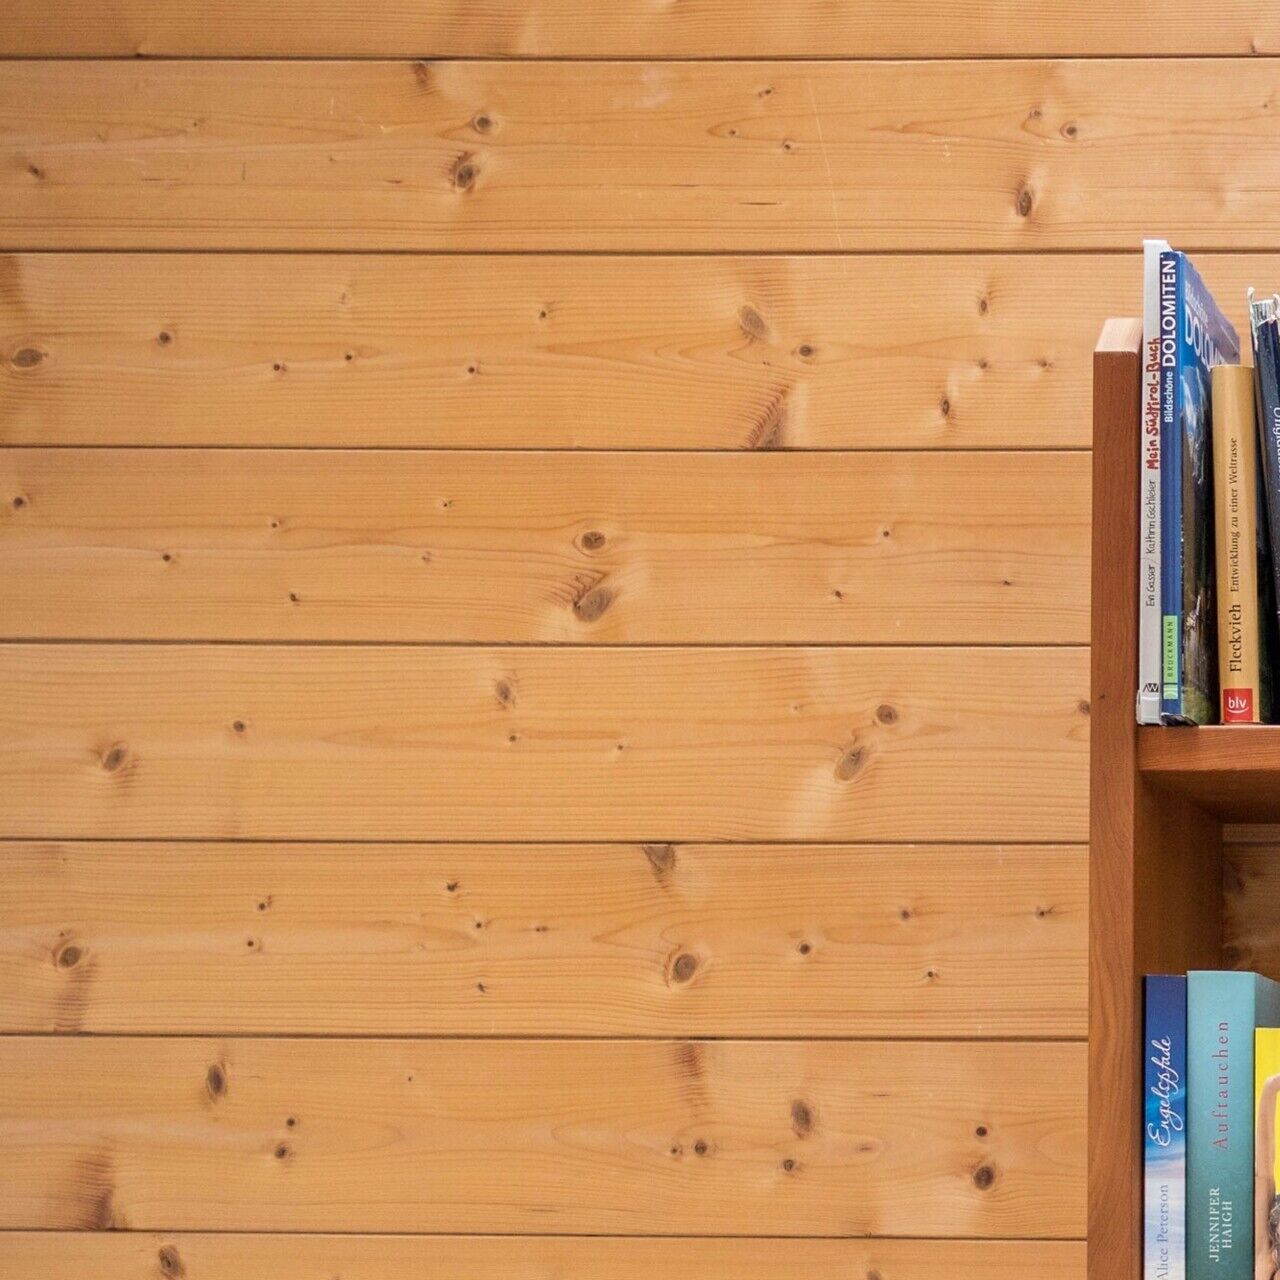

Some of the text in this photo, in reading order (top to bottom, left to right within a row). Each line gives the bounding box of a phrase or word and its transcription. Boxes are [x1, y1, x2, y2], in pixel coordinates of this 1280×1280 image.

[1162, 261, 1176, 422] Bildschöne DOLOMITEN
[1147, 442, 1158, 470] Mein
[1228, 437, 1242, 672] Fleckvieh Entwicklung zu einer Weltrasse
[1228, 697, 1246, 708] blv
[1148, 1036, 1183, 1147] Engelspfade
[1212, 1022, 1228, 1150] Auftauchen
[1209, 1188, 1220, 1262] JENNIFER
[1222, 1201, 1232, 1248] HAIGH
